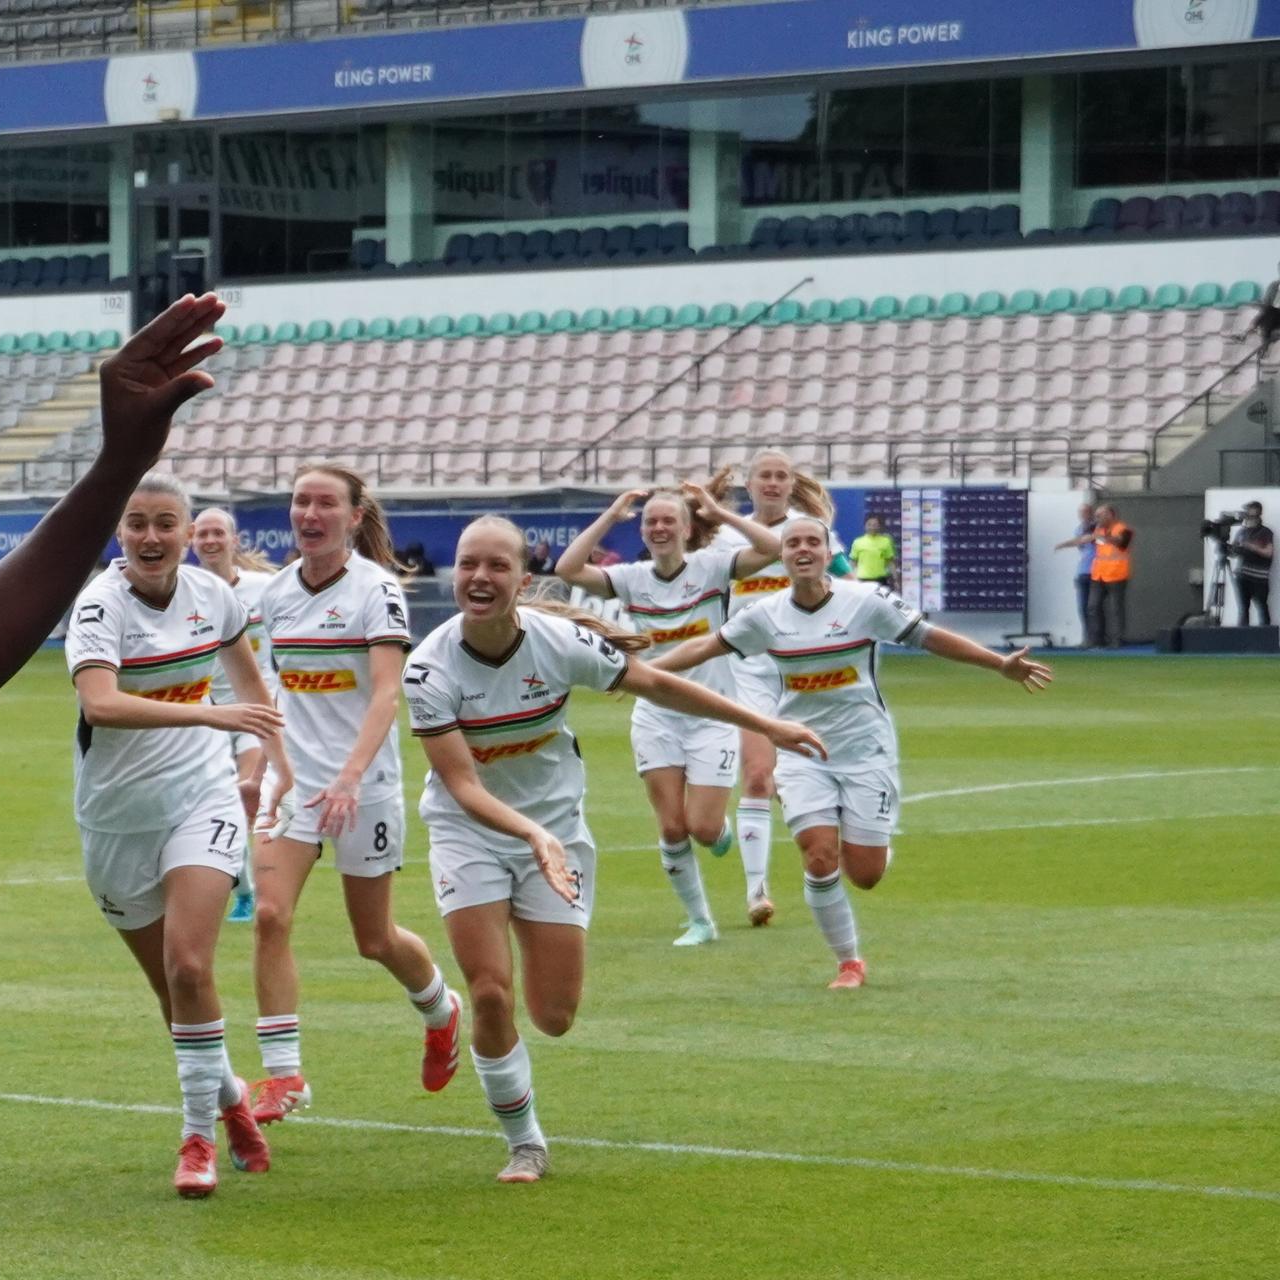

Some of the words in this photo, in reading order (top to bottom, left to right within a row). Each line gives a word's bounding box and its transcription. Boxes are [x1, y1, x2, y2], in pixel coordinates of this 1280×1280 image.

[847, 29, 893, 48] KING
[897, 24, 960, 44] POWER
[335, 69, 374, 87] KING
[378, 64, 433, 84] POWER
[103, 297, 122, 310] 102
[255, 529, 294, 548] POW
[523, 526, 579, 546] OWER
[281, 672, 342, 690] DHL
[790, 671, 848, 690] DHL
[719, 750, 735, 770] 27
[210, 818, 238, 850] 77
[373, 820, 388, 852] 8
